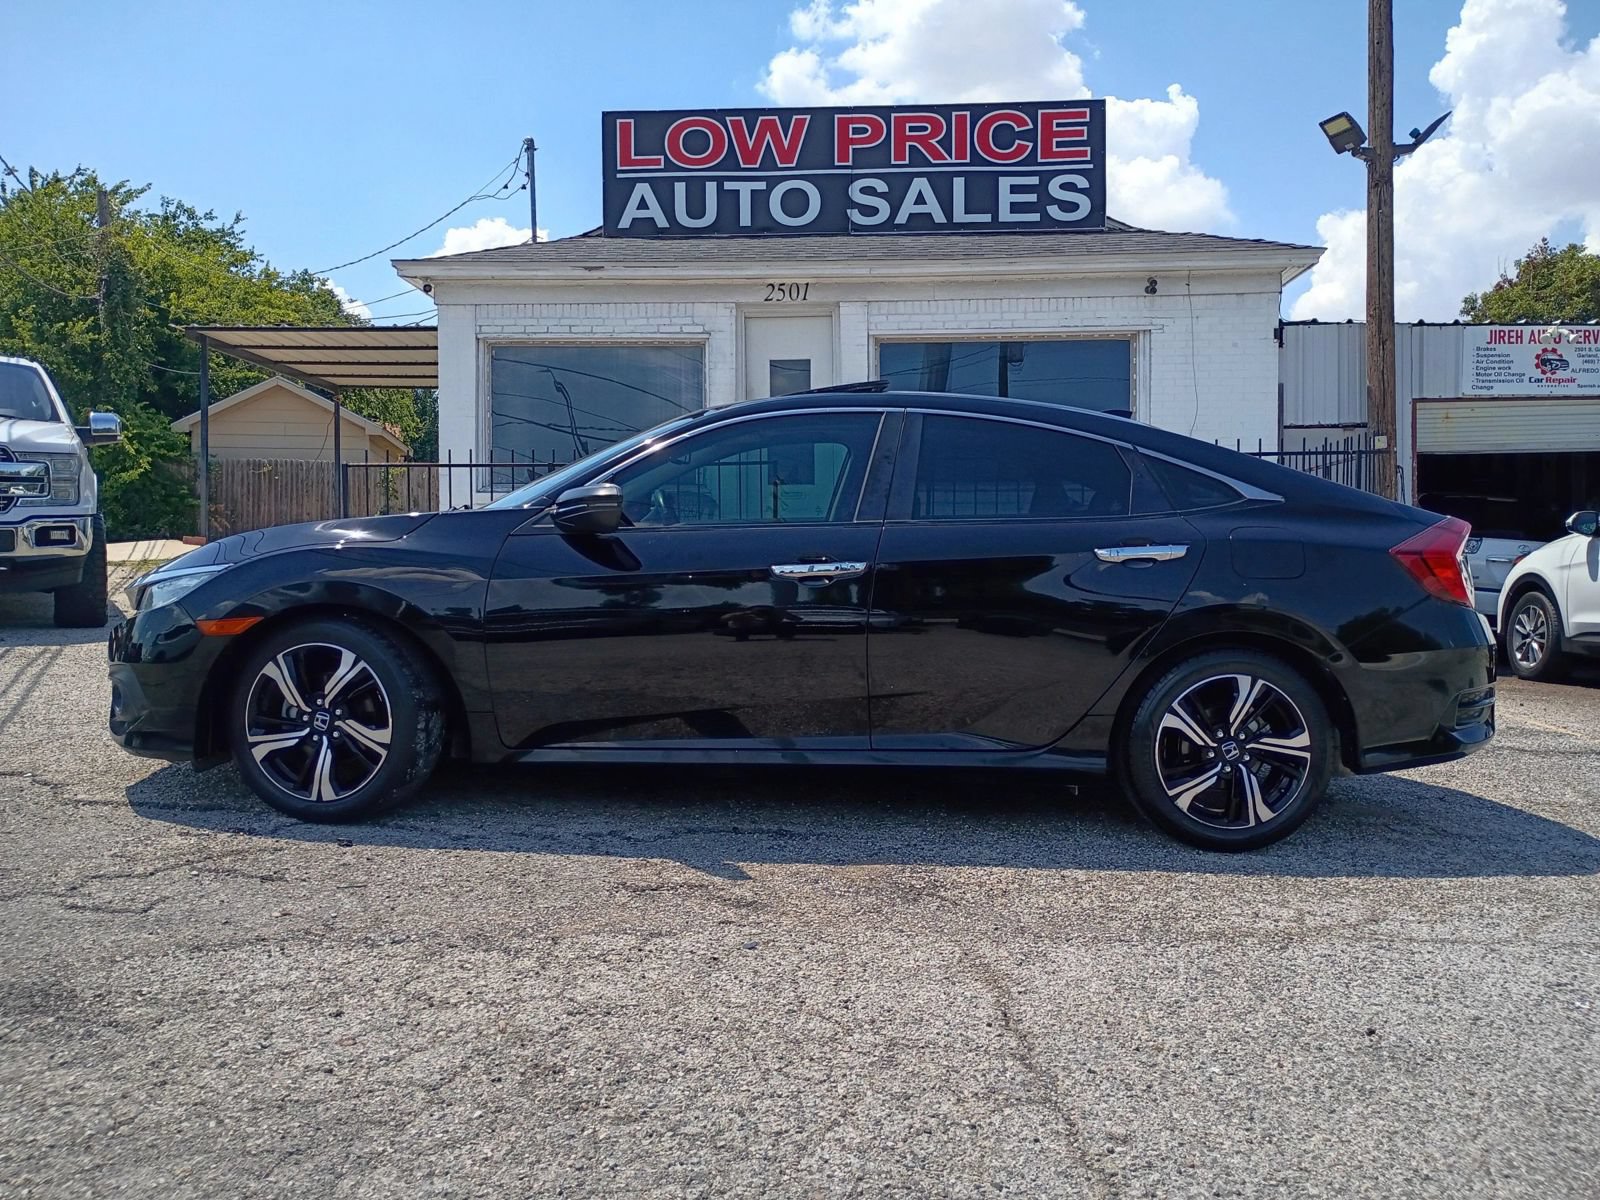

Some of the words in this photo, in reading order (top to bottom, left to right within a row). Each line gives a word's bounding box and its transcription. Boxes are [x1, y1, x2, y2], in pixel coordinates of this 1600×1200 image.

[616, 115, 811, 169] LOW
[834, 108, 1091, 166] PRICE
[618, 180, 822, 229] AUTO
[846, 174, 1092, 225] SALES
[764, 282, 810, 302] 2501
[1486, 329, 1523, 345] JIREH
[1528, 329, 1562, 345] AUO
[1528, 376, 1545, 384] Car
[1545, 376, 1577, 385] Repair
